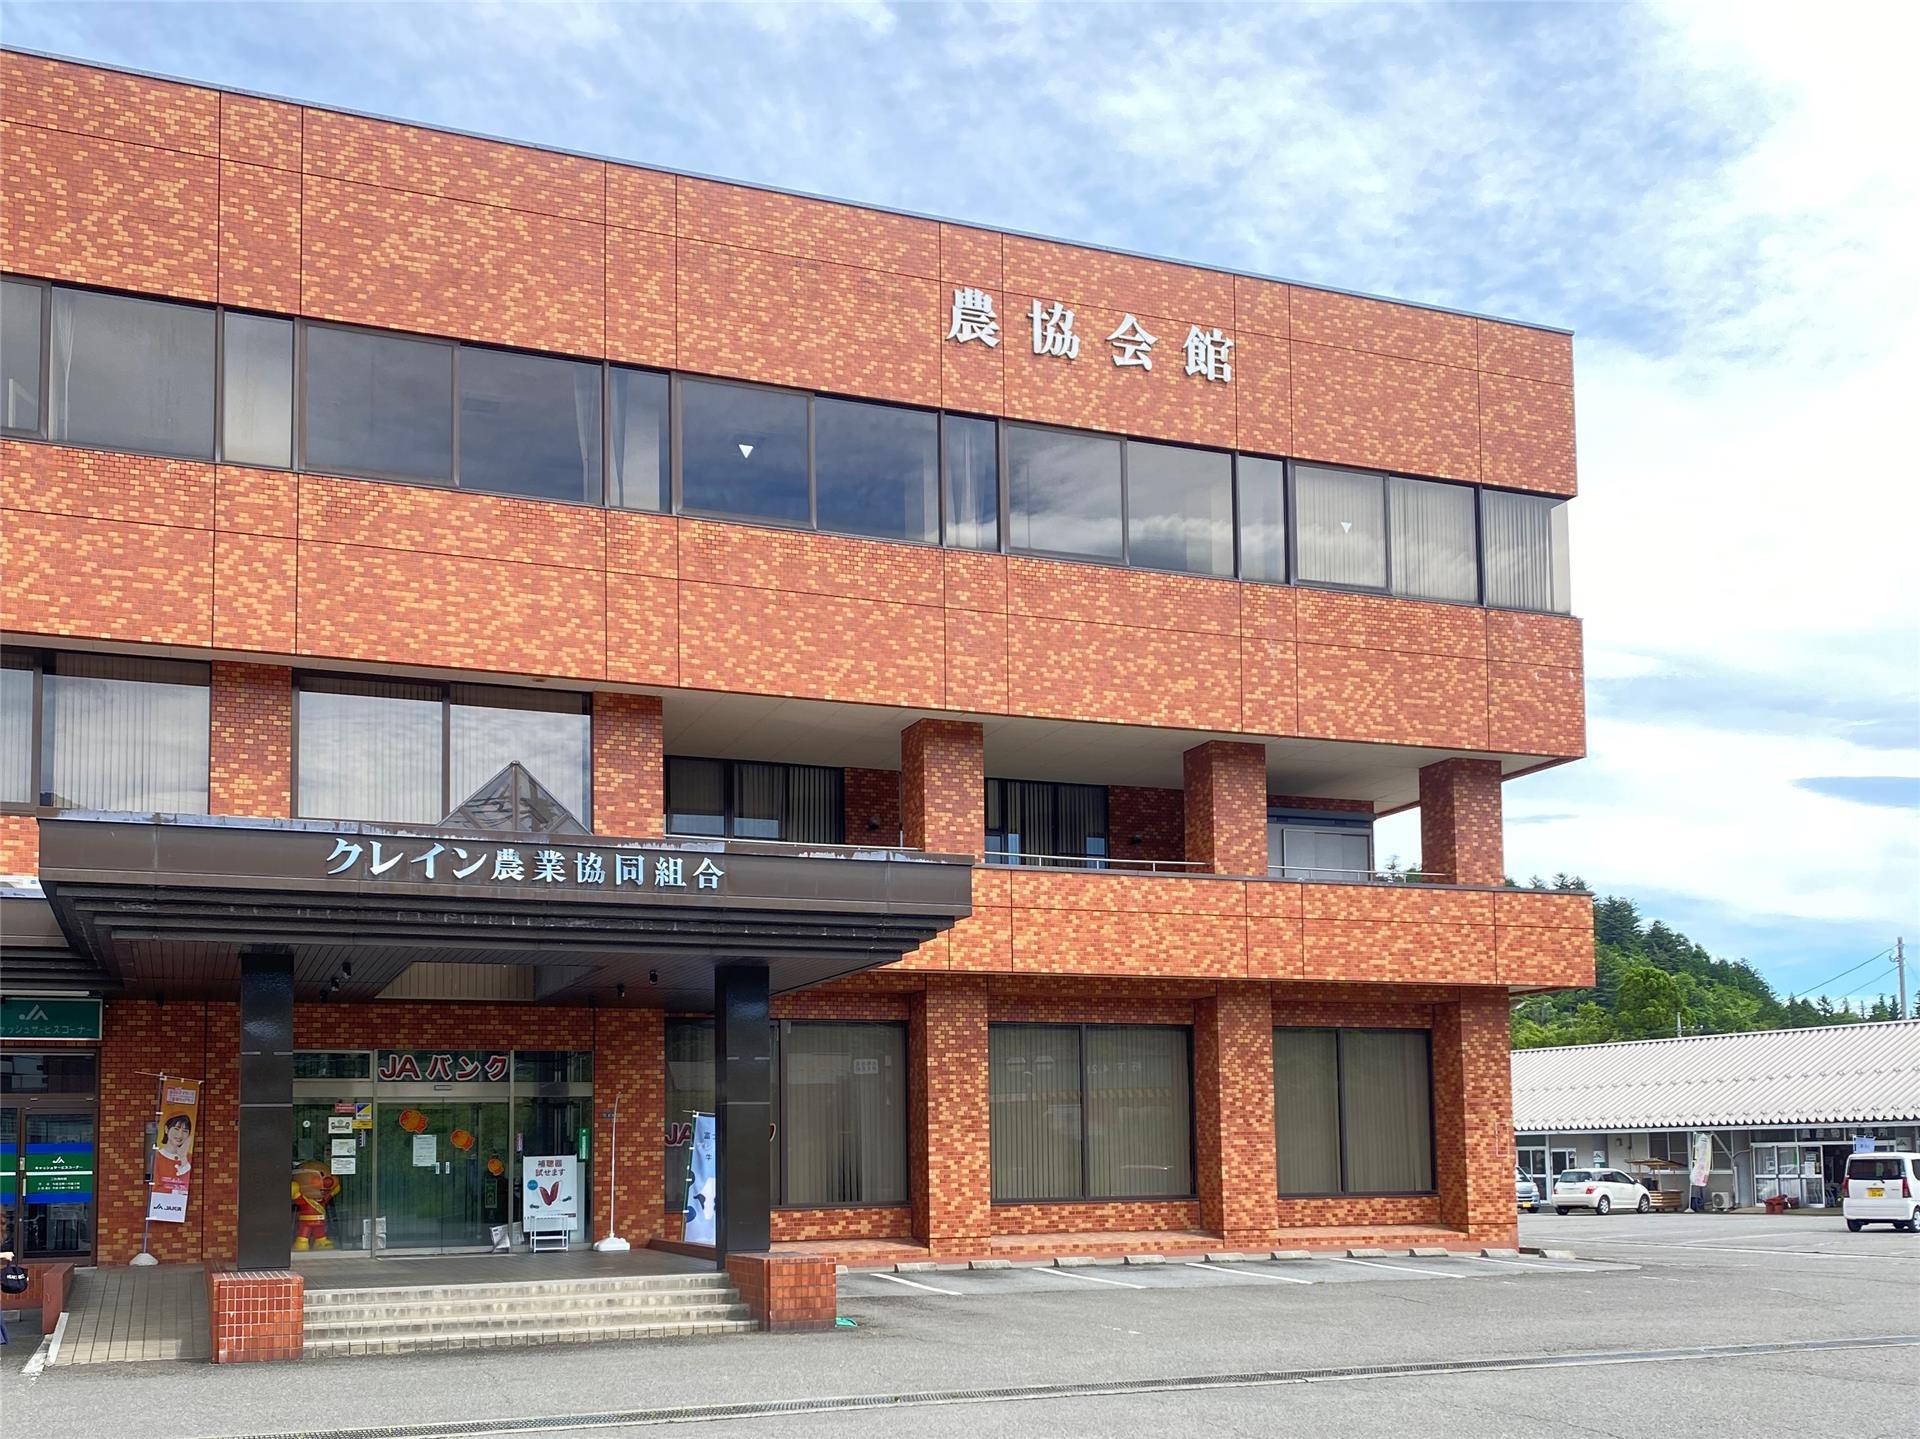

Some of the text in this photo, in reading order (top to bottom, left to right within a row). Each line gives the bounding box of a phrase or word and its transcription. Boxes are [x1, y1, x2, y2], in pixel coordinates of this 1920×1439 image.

[945, 287, 1234, 383] 農協会館
[326, 838, 725, 889] クレイン農業協同組合
[379, 1055, 508, 1080] JAバンク
